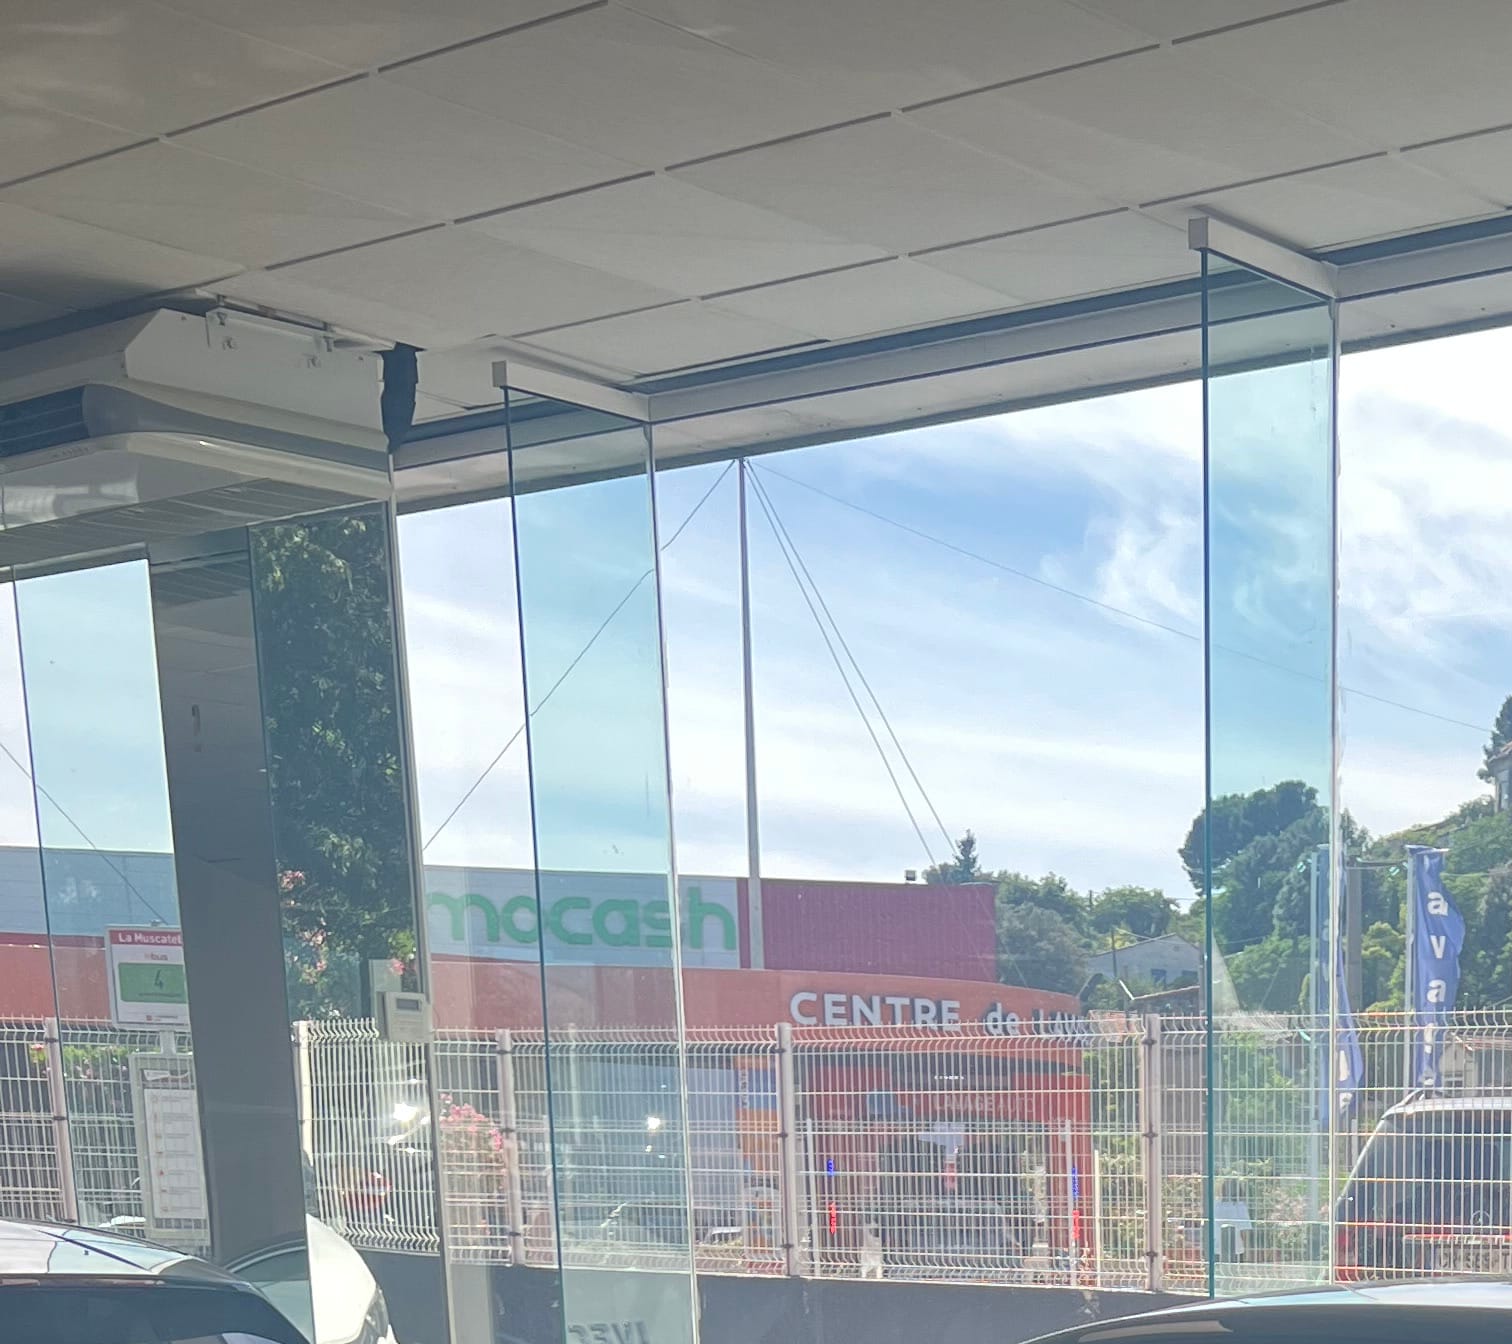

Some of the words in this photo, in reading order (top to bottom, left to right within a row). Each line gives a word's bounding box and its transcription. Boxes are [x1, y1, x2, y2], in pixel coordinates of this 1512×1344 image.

[119, 933, 132, 943] La
[790, 991, 961, 1032] CENTRE
[986, 1003, 1020, 1036] de
